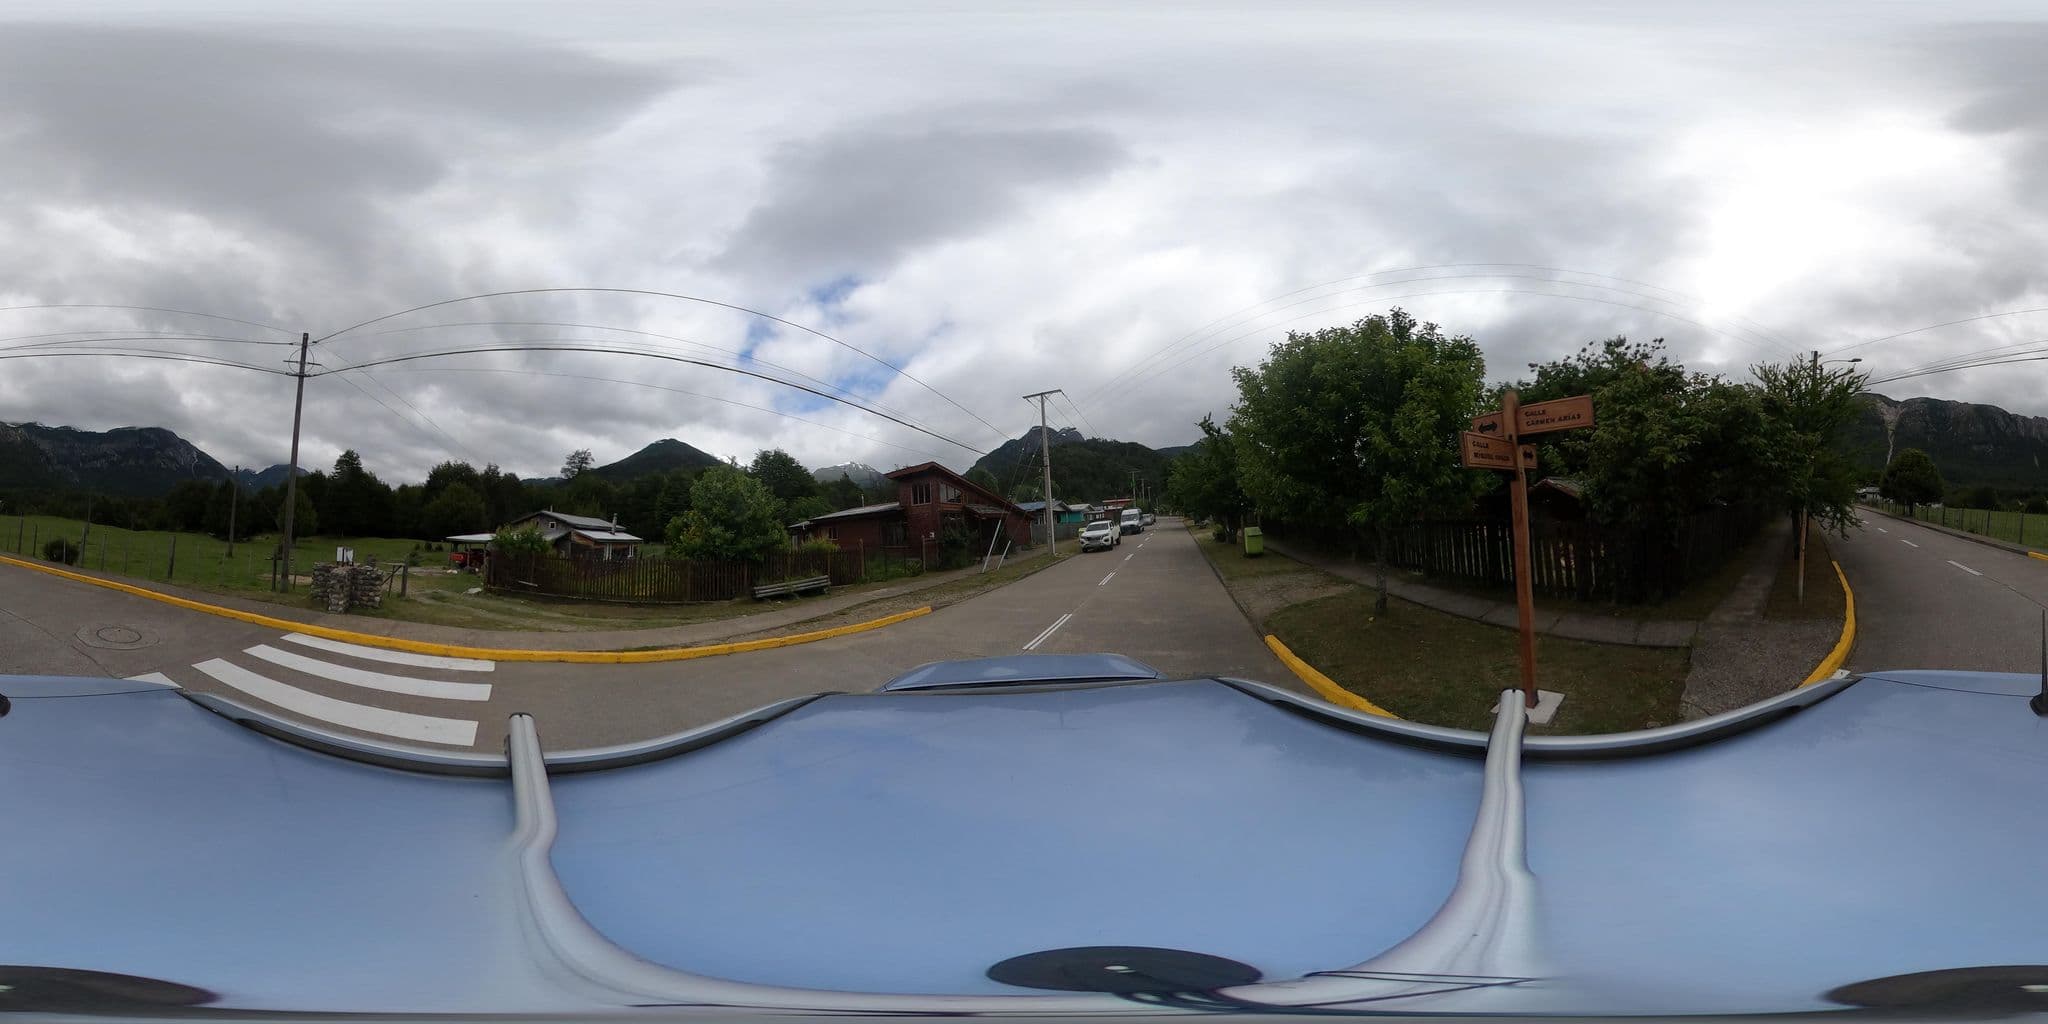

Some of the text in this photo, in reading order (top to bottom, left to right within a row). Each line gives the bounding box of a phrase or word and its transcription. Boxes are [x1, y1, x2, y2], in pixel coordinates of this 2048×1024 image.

[1524, 409, 1546, 417] CALLE
[1526, 413, 1581, 426] CARMEN ARIAS
